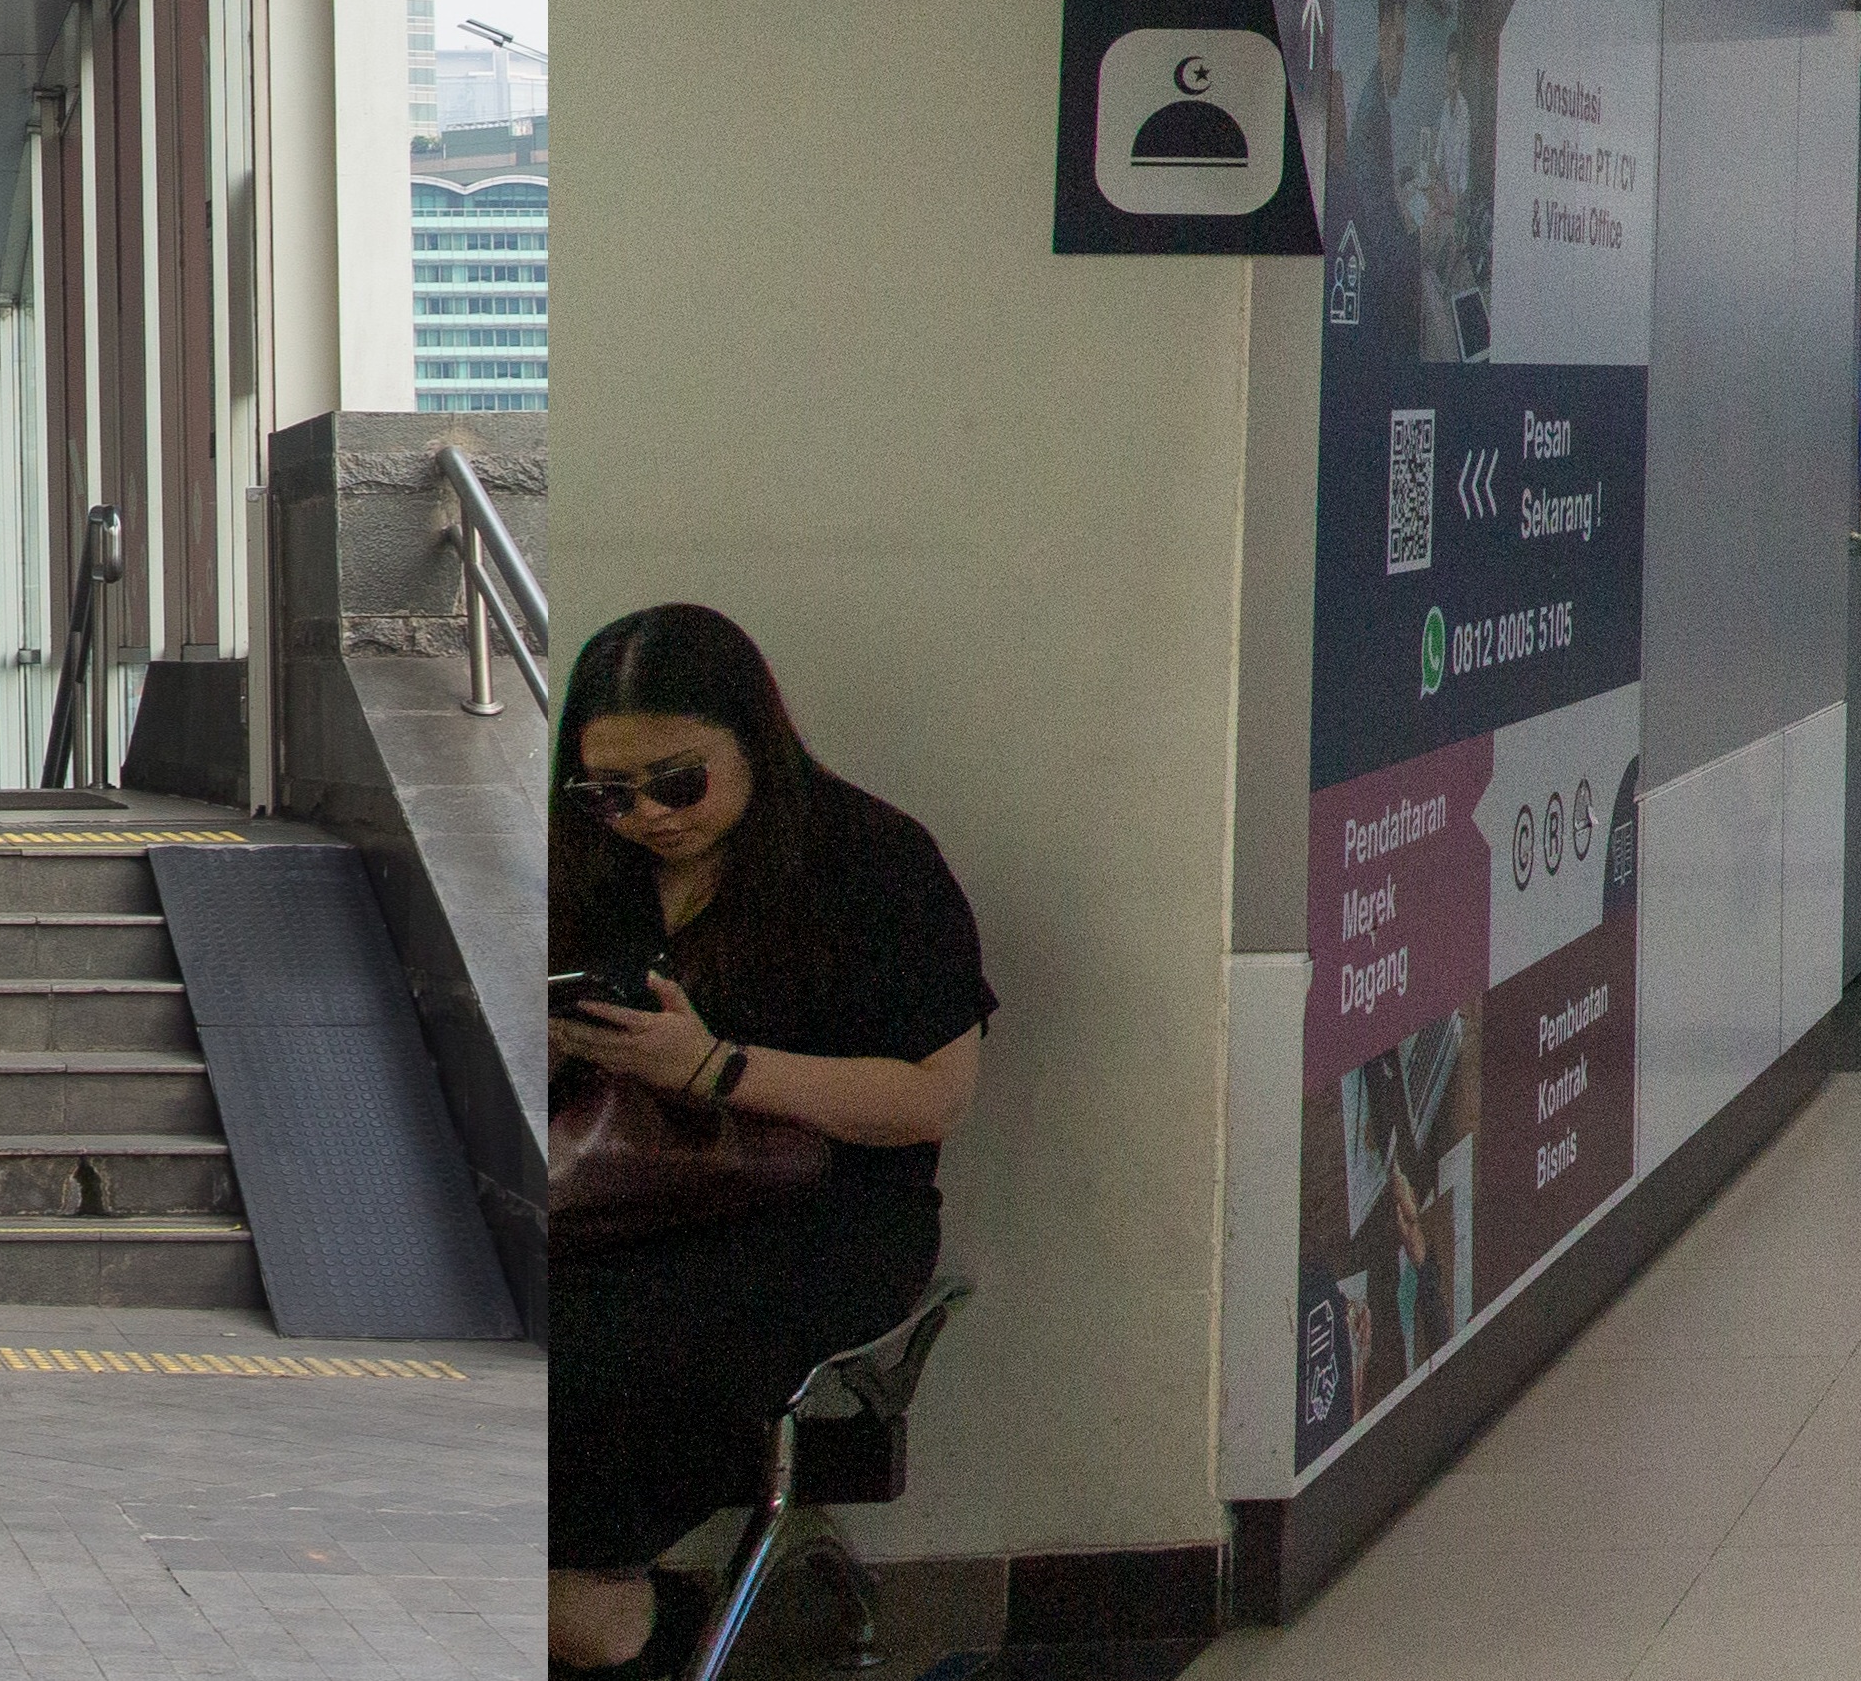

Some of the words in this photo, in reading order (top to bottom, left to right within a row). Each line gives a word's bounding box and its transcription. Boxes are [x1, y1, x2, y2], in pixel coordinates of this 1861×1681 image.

[1536, 68, 1602, 125] Konsultasi
[1534, 133, 1592, 186] Pendirian
[1545, 202, 1586, 244] Virtual
[1589, 207, 1623, 250] Office
[1523, 409, 1571, 459] Pesan
[1521, 488, 1592, 542] Sekarang
[1453, 619, 1494, 676] 0812
[1498, 609, 1534, 664] 8005
[1538, 601, 1573, 652] 5105
[1345, 792, 1446, 870] Pendaftaran
[1341, 875, 1398, 944] Merek
[1340, 941, 1408, 1016] Dagang
[1537, 982, 1609, 1057] Pembuatan
[1536, 1054, 1588, 1124] Kontrak
[1536, 1127, 1577, 1191] Bisnis
